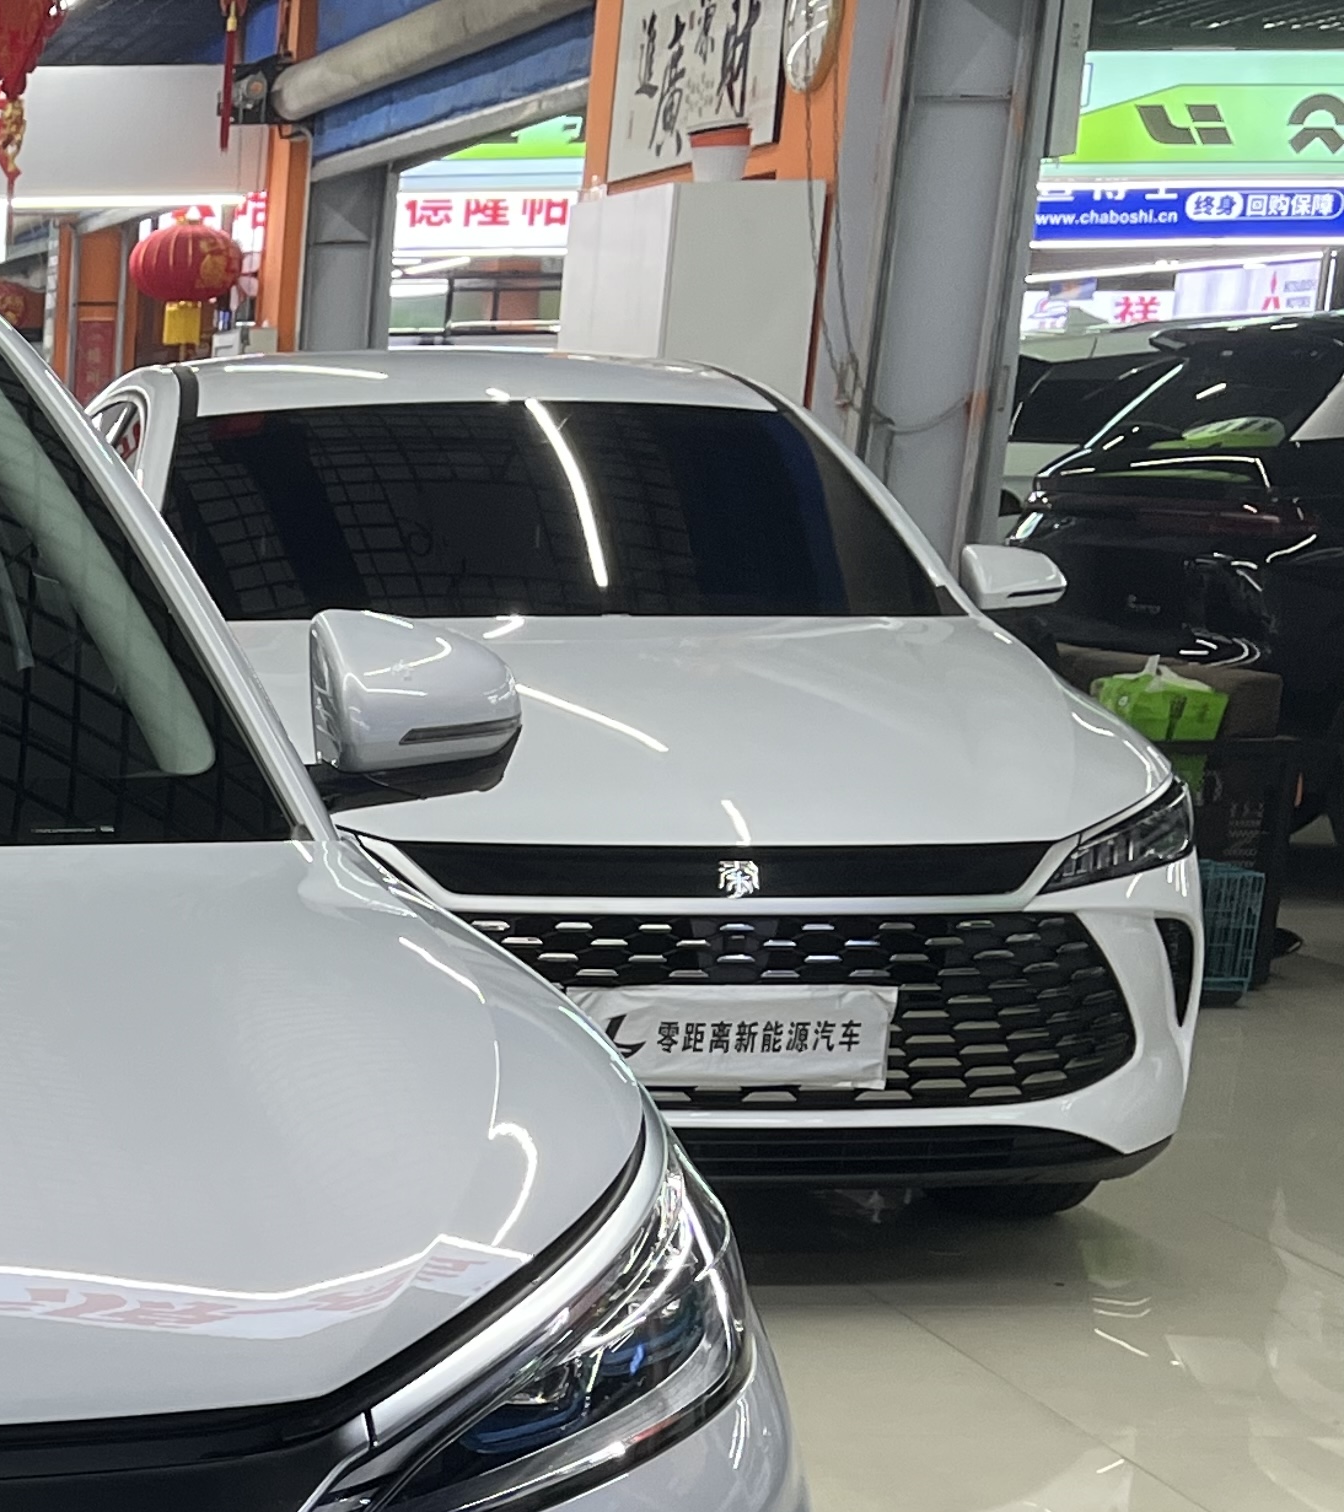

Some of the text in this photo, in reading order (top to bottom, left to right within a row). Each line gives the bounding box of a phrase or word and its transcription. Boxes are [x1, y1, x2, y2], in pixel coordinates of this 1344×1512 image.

[1193, 193, 1335, 217] 终身 回购保障
[656, 1019, 862, 1053] 零距离新能源汽车
